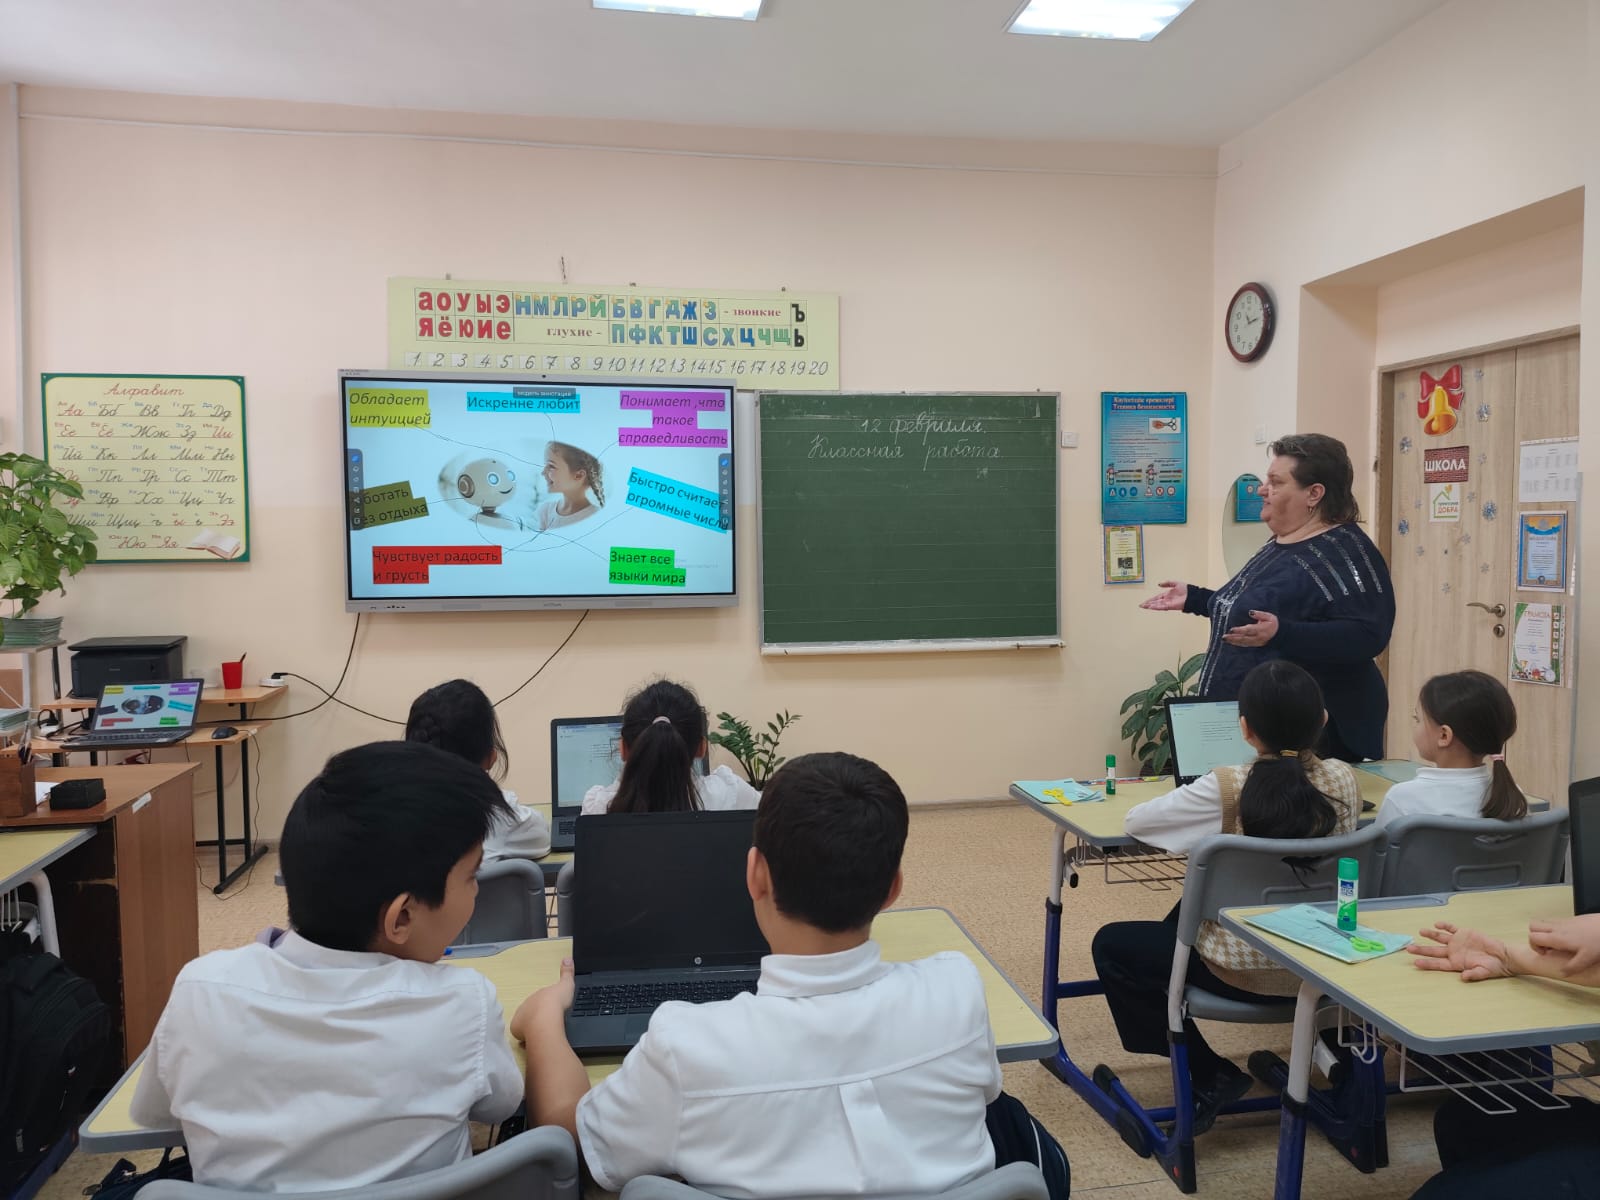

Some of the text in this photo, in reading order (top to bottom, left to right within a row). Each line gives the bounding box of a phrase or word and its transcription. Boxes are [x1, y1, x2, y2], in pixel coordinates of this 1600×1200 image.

[734, 309, 782, 317] звонкие
[547, 328, 593, 338] глухие
[413, 352, 828, 375] 1 2 3 4 5 6 7 8 9 10 11 12 13 14 15 16 17 18 19 20
[104, 383, 184, 400] Алфавит
[349, 392, 425, 406] Обладает
[467, 396, 580, 411] Искренне любит
[620, 394, 691, 407] Понимает
[350, 412, 431, 427] интуицией
[653, 416, 694, 425] такое
[861, 418, 881, 432] 12
[618, 432, 728, 446] справедливость
[808, 434, 1000, 471] Классная работа
[1425, 459, 1466, 472] ШКОЛА
[629, 471, 675, 494] Быстро
[363, 488, 409, 505] ботать
[379, 504, 428, 520] отдыха
[627, 493, 691, 518] огромные
[373, 551, 498, 563] Чувствует радость
[610, 551, 646, 563] Знает
[650, 556, 671, 565] все
[374, 571, 429, 583] и грусть
[609, 571, 686, 585] языки мира
